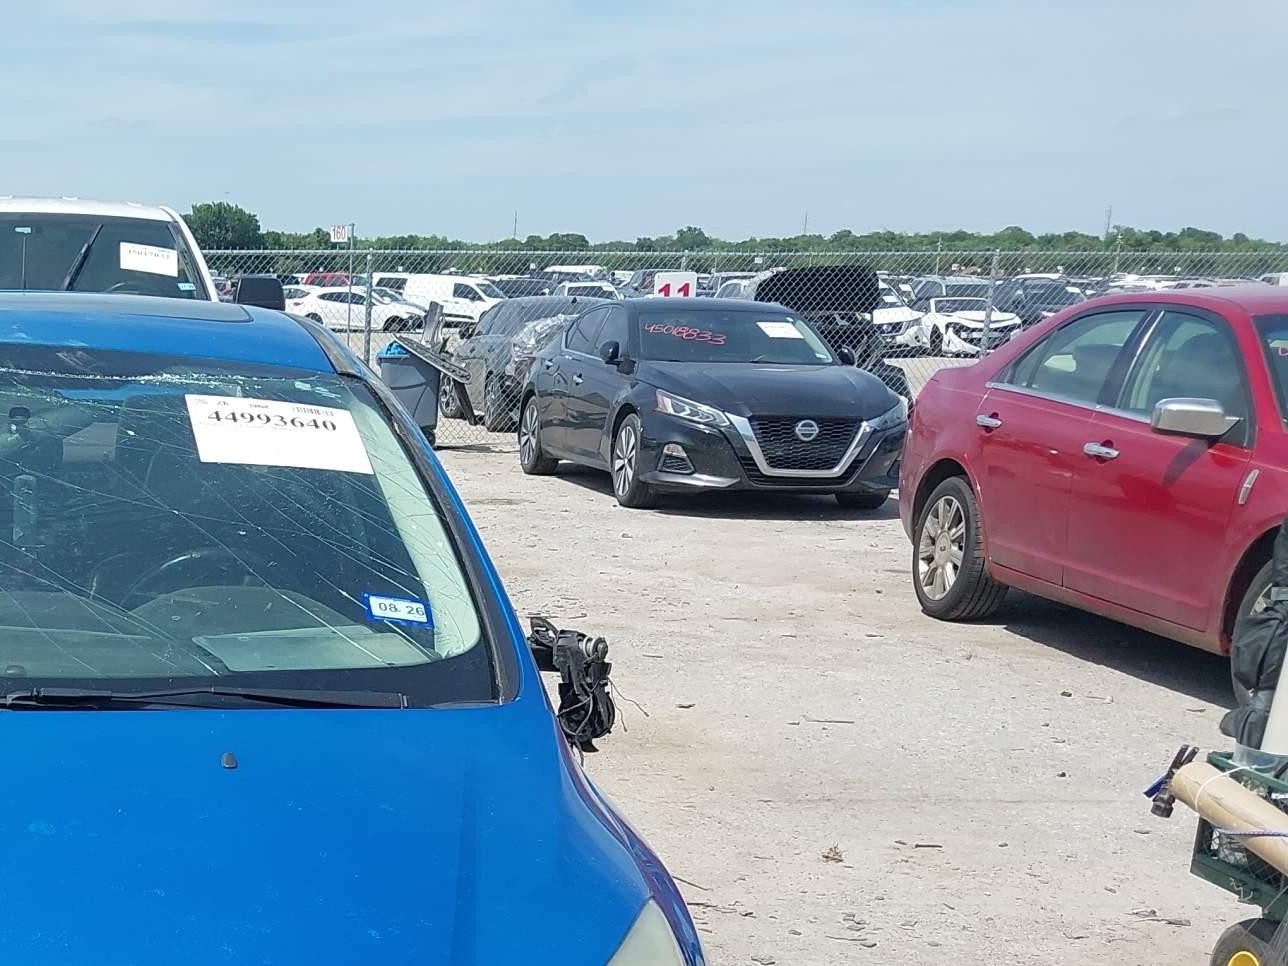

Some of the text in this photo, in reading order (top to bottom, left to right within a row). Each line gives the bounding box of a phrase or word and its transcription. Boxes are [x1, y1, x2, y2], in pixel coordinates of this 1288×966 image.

[332, 224, 346, 241] 160
[644, 322, 727, 345] 45018833
[207, 409, 337, 431] 44993640
[406, 605, 425, 617] 26
